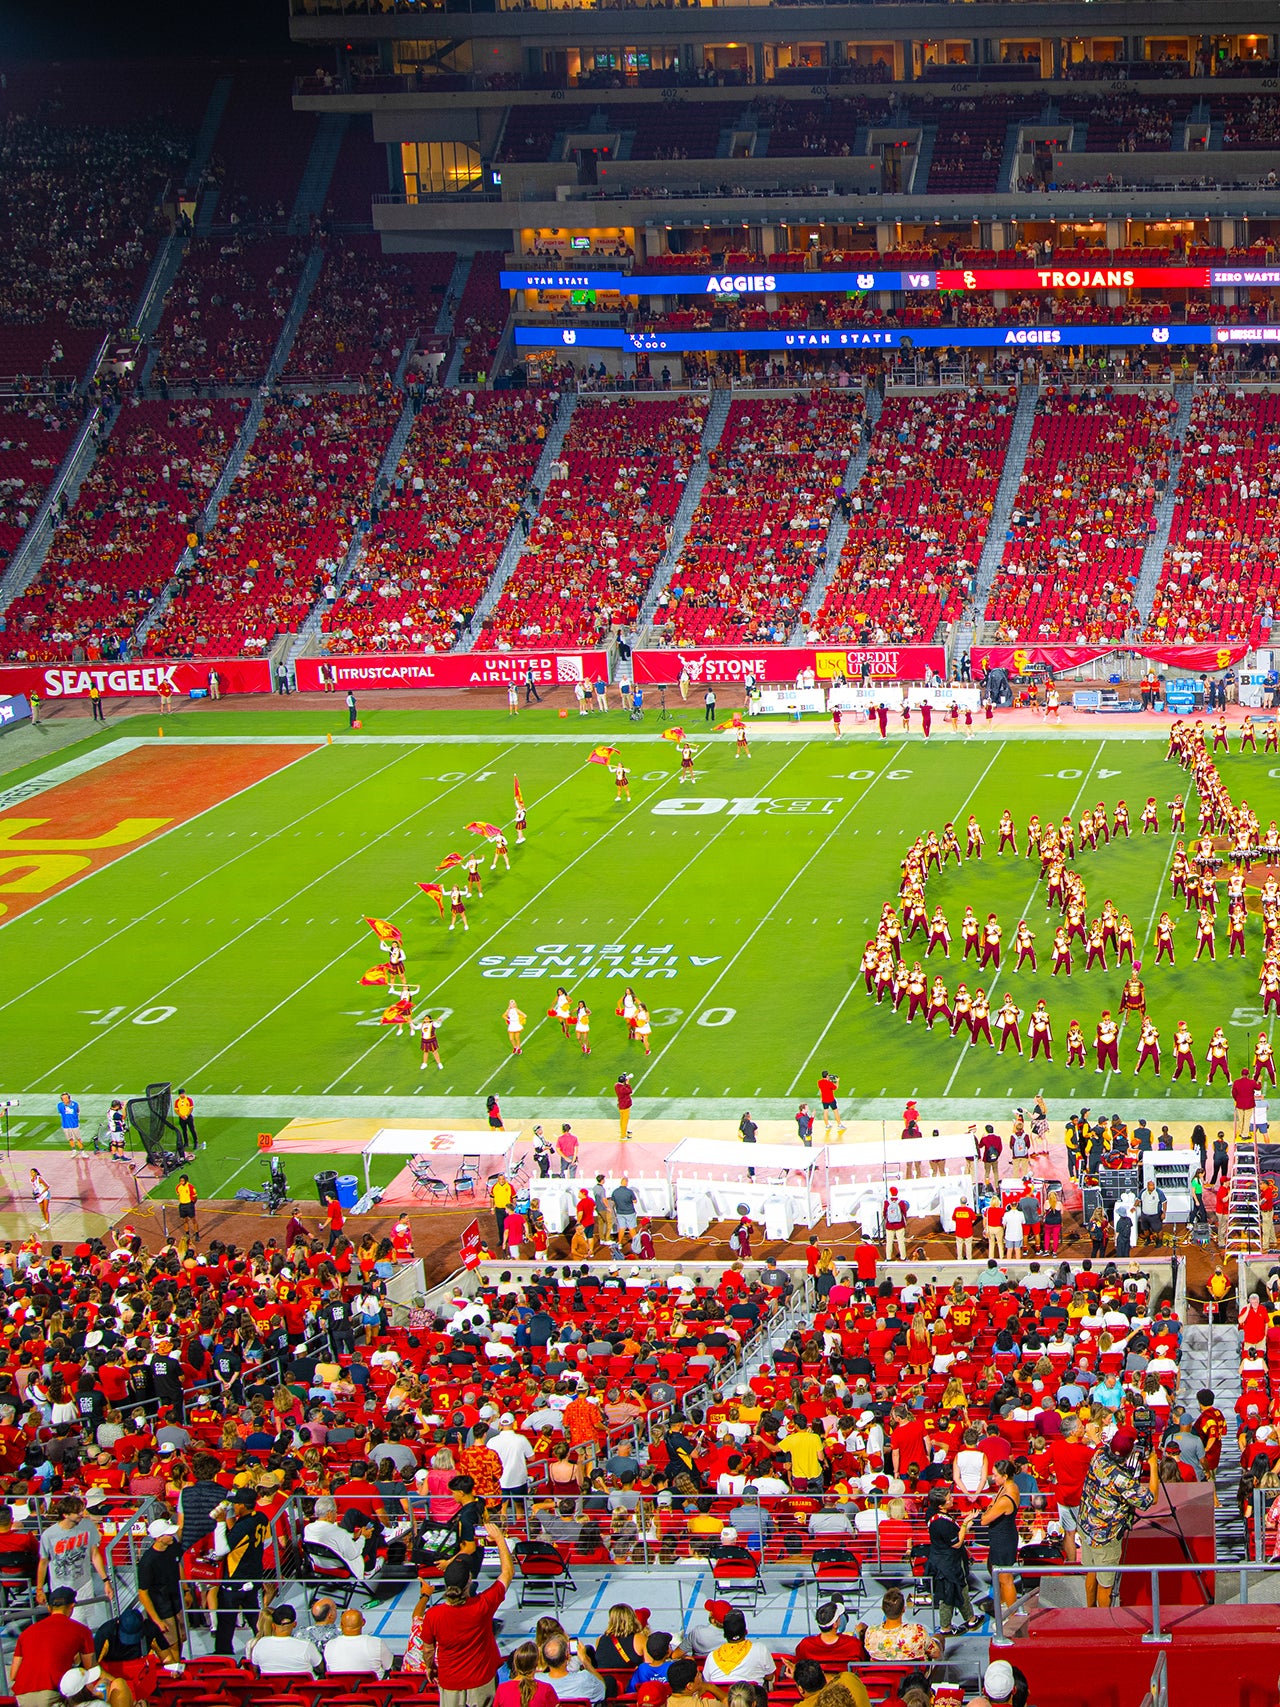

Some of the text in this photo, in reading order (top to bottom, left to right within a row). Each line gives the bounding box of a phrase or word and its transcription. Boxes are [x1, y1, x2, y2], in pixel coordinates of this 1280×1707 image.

[810, 86, 827, 95] 403
[1110, 81, 1127, 90] 405
[1261, 79, 1278, 89] 406
[550, 90, 565, 100] 401
[661, 89, 677, 98] 402
[527, 277, 589, 285] UTAH STATE
[706, 275, 777, 292] AGGIES
[908, 274, 930, 288] VS
[1037, 270, 1135, 288] TROJANS
[1214, 272, 1242, 282] ZERO
[1244, 272, 1280, 282] WASTE
[785, 333, 892, 345] UTAH STATE
[1004, 330, 1061, 344] AGGIES
[818, 654, 847, 672] USC
[847, 651, 900, 663] CREDIT
[485, 658, 552, 671] UNITED
[705, 659, 766, 674] STONE
[847, 662, 898, 675] UION
[338, 665, 435, 681] ITRUSTCAPITAL
[44, 665, 181, 697] SEATGEEK
[534, 943, 676, 955] FIELD
[477, 955, 723, 967] AIRLINES
[480, 967, 679, 979] UNITED
[89, 1005, 179, 1026] 10
[649, 1006, 738, 1027] 30
[259, 1135, 270, 1146] 20
[279, 1285, 290, 1300] 9
[952, 1311, 972, 1326] 96
[438, 1393, 450, 1409] 3
